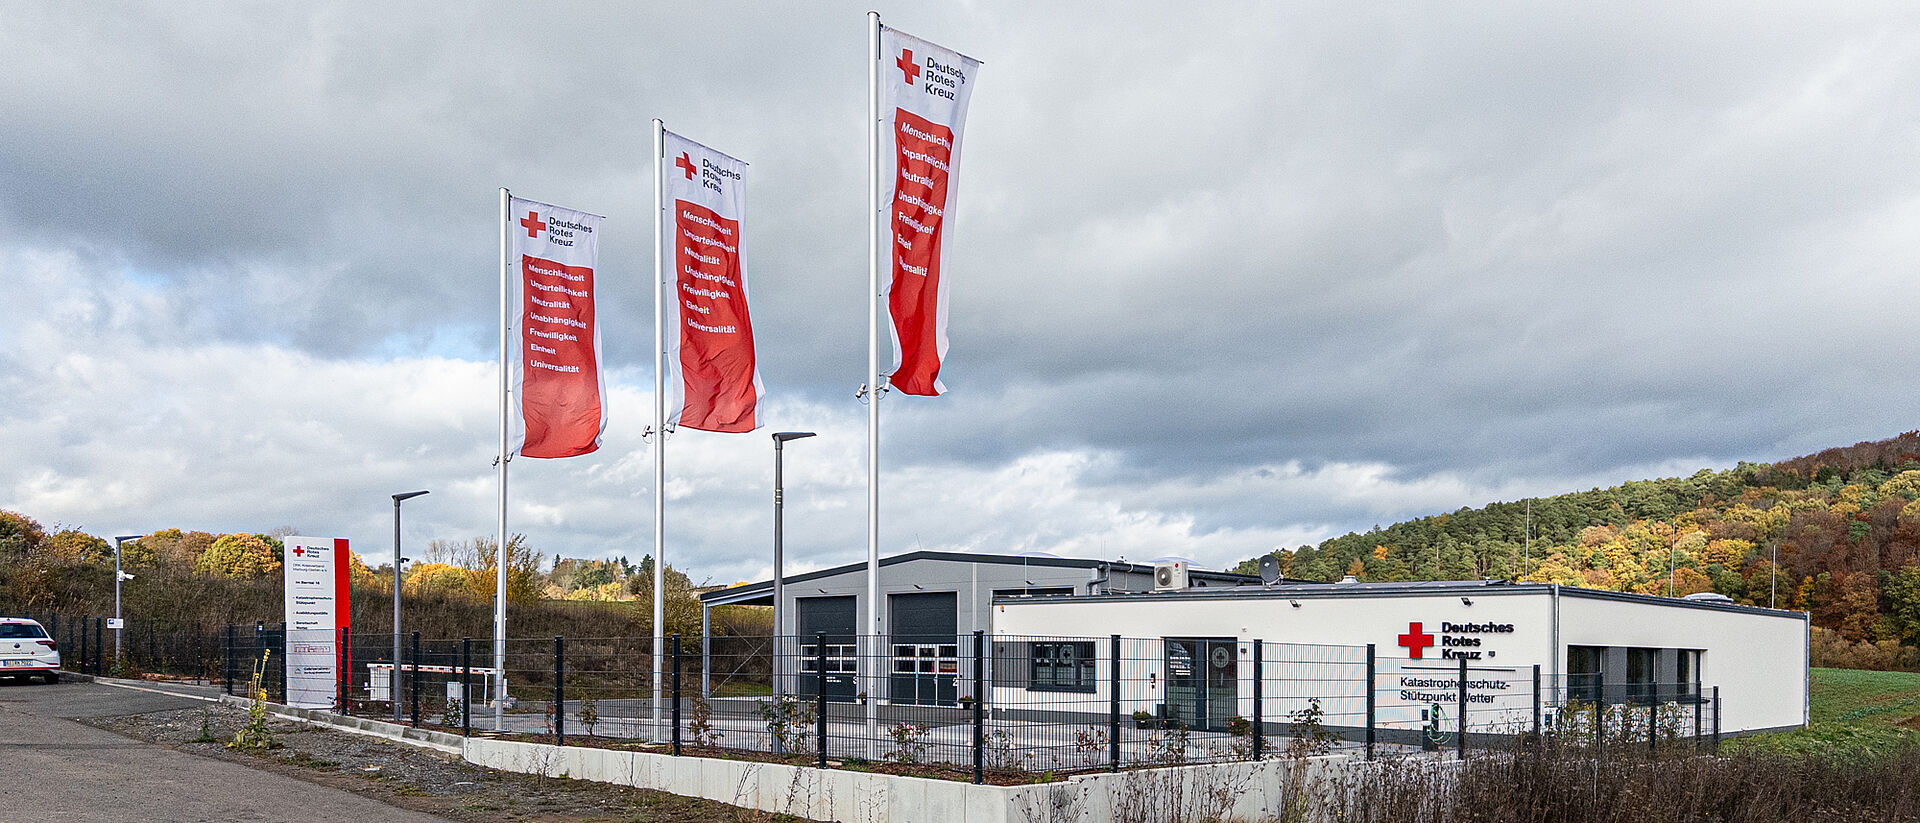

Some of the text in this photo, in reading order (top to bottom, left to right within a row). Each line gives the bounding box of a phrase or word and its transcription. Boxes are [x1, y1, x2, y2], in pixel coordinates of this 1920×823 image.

[926, 70, 956, 88] Rotes
[925, 83, 955, 101] Kreuz
[549, 217, 593, 233] Deutsches
[549, 226, 574, 238] Rotes
[549, 235, 574, 247] Kreuz
[528, 264, 584, 282] Menschlichkeit
[530, 279, 588, 298] Unparteilichkeit
[531, 295, 570, 309] Neutralität
[530, 312, 586, 329] Unabhängigkeit
[530, 343, 556, 355] Einheit
[530, 360, 579, 373] Universalität
[1441, 621, 1515, 634] Deutsches
[1442, 635, 1482, 647] Rotes
[1400, 690, 1457, 703] Stützpunkt
